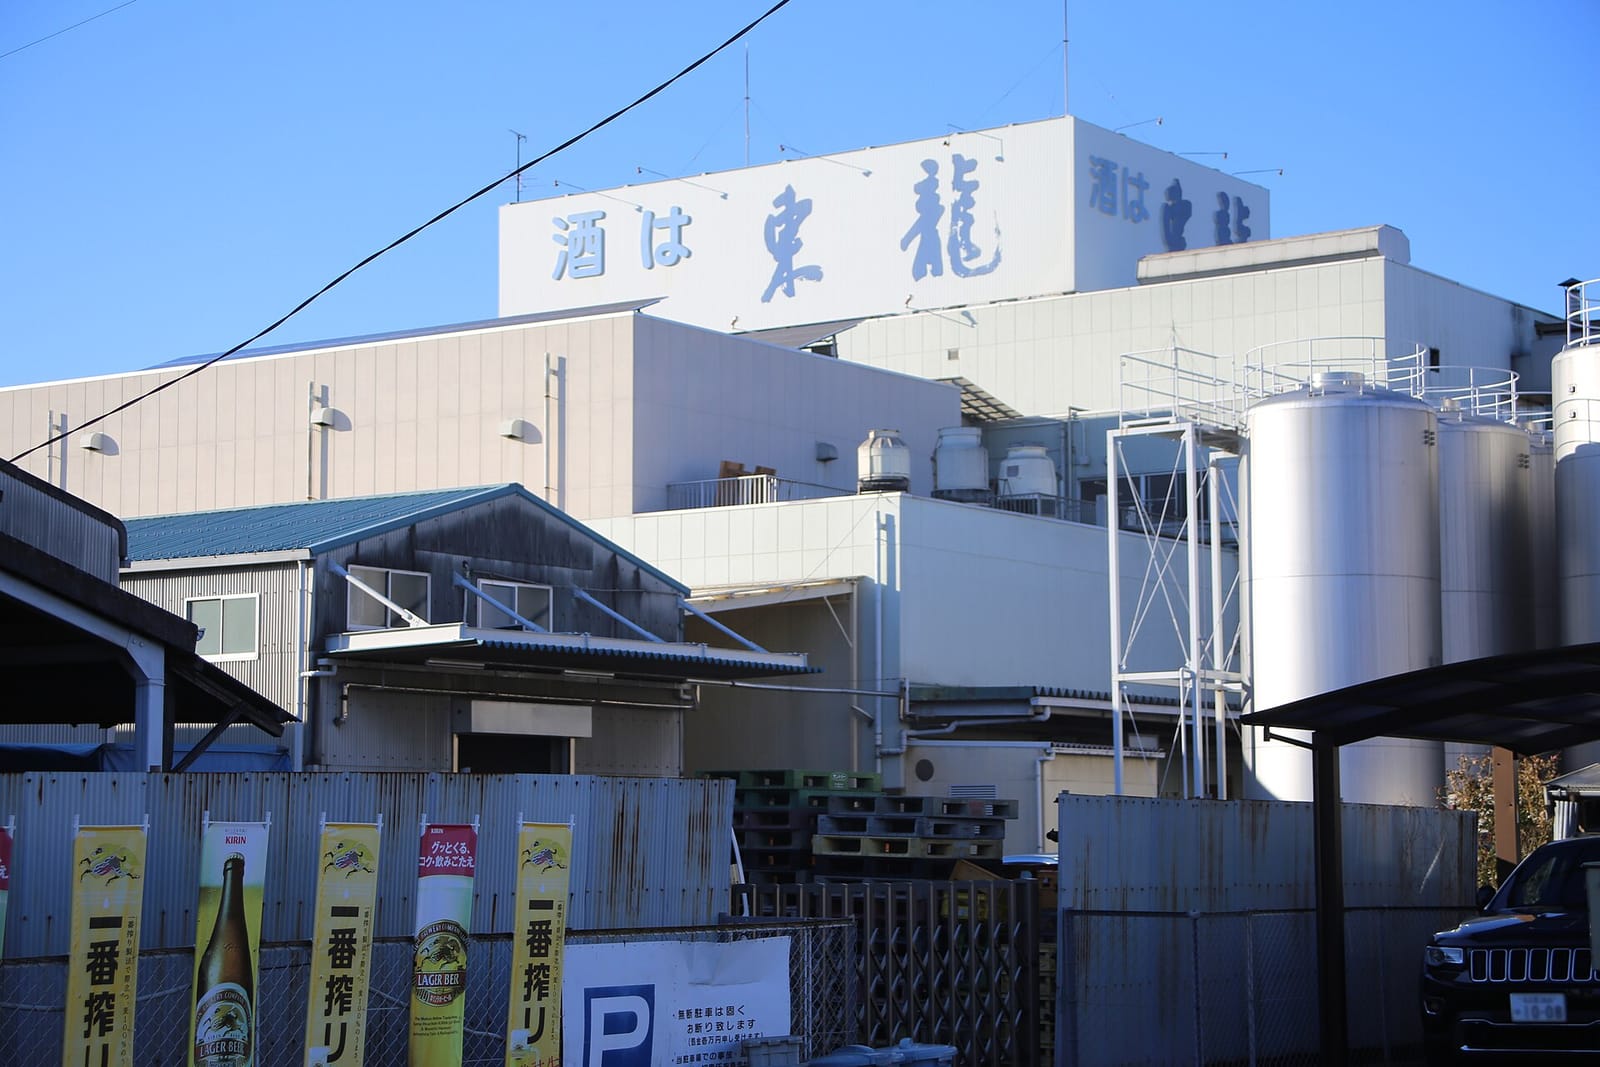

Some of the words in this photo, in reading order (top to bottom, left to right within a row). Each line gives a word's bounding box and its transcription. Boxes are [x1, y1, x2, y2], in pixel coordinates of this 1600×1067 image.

[225, 836, 246, 844] KIRIN
[324, 906, 359, 1063] 一番搾り
[523, 900, 554, 1045] 一番搾り
[590, 995, 650, 1067] P
[687, 1018, 757, 1034] お断り致します
[200, 1042, 226, 1057] LAGER
